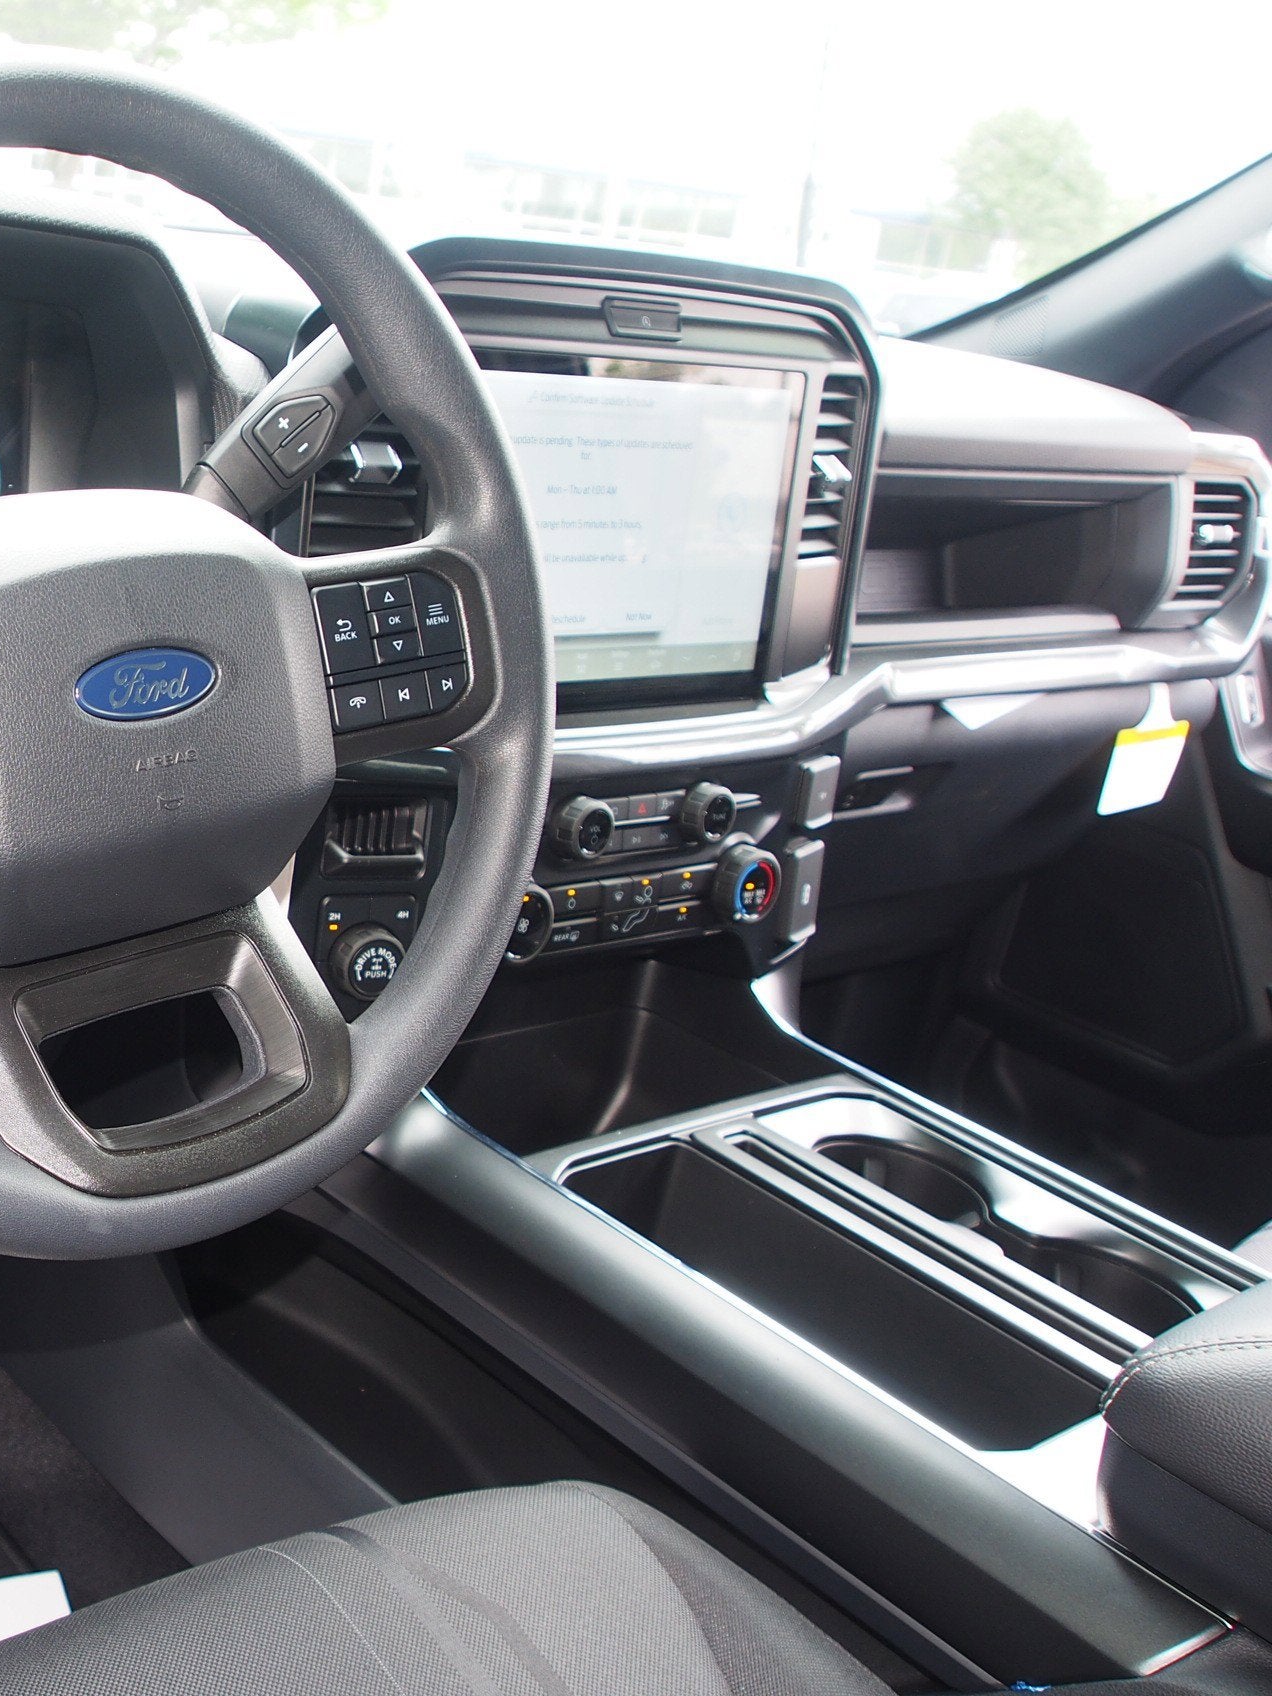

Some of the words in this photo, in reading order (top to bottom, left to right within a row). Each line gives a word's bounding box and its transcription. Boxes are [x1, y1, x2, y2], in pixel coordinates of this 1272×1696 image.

[388, 615, 401, 625] OK
[426, 615, 450, 626] MENU
[334, 630, 358, 643] BACK
[109, 660, 190, 709] Ford
[328, 912, 341, 921] 2H
[397, 911, 409, 919] 4H
[554, 933, 570, 942] REAR
[355, 947, 377, 971] DRIVE
[378, 947, 397, 968] MODE
[365, 970, 387, 978] PUSH
